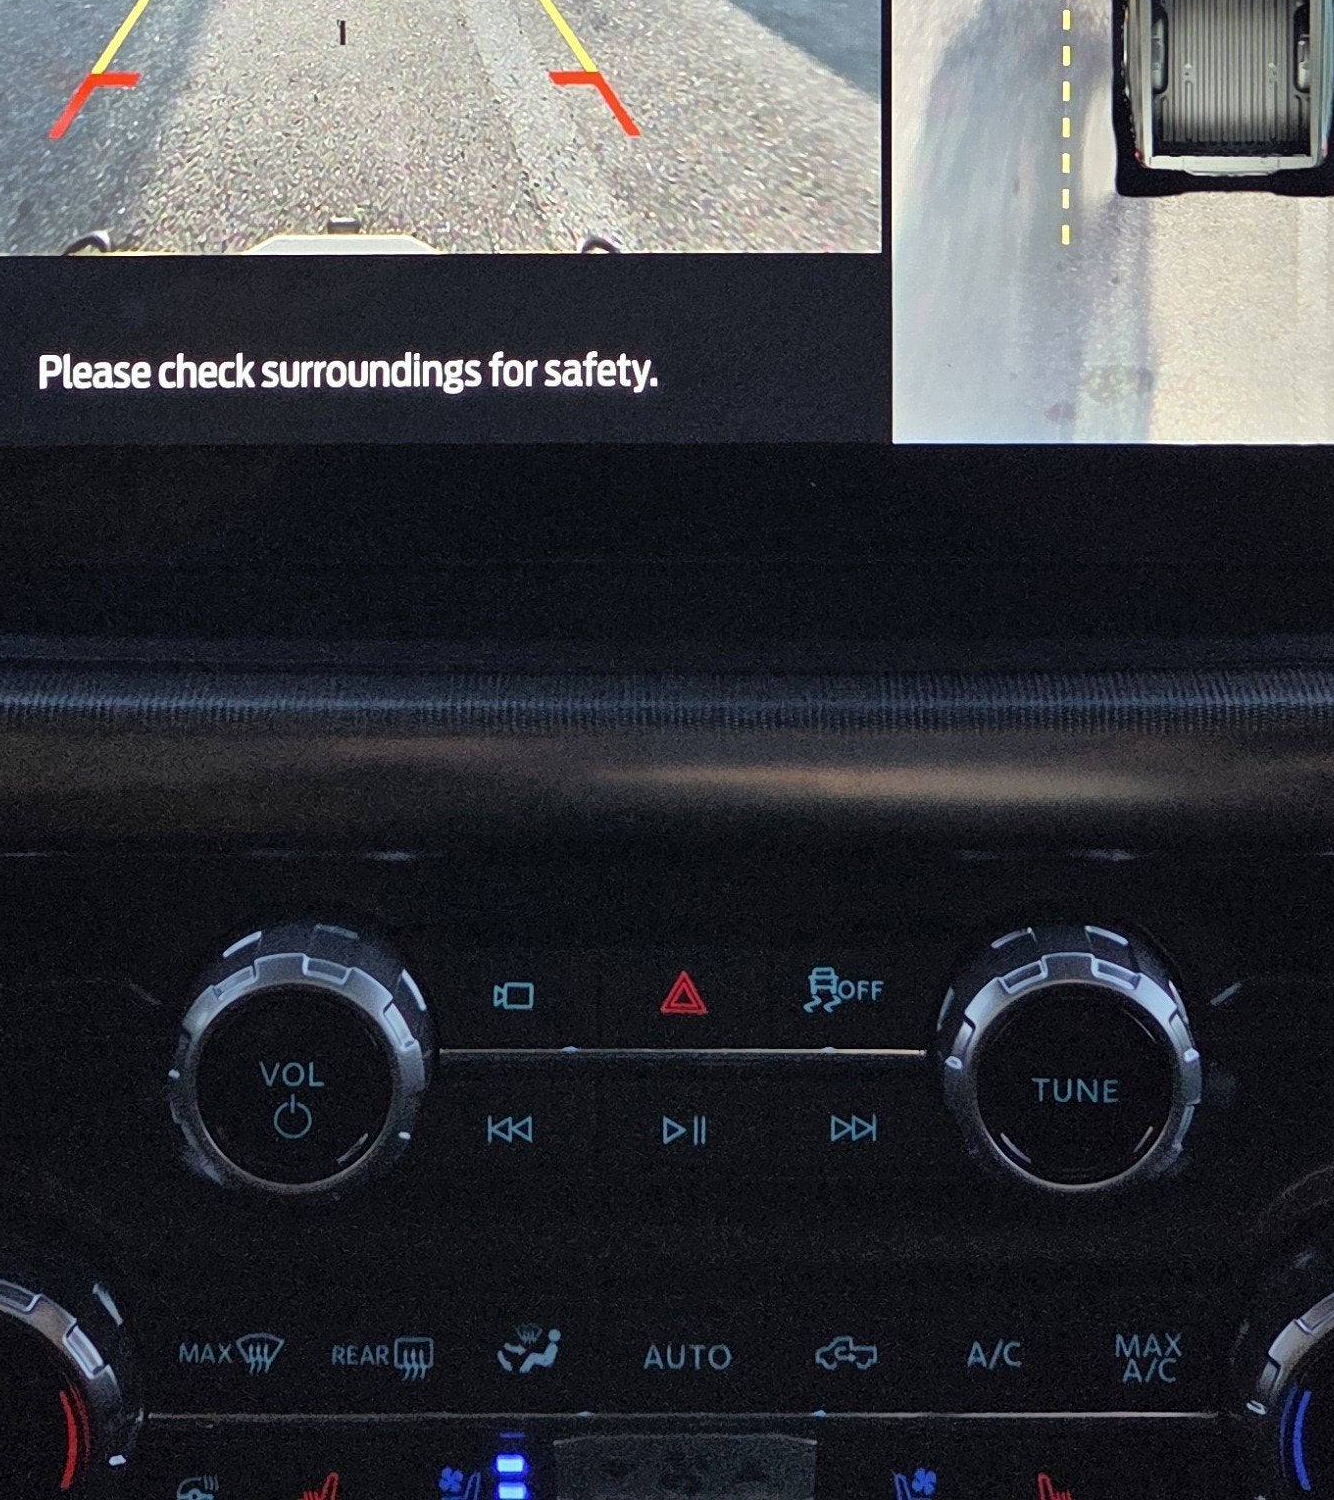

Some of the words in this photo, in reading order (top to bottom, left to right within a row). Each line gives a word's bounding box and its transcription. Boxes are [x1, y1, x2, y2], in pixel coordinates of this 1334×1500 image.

[39, 354, 151, 389] Please
[158, 353, 255, 388] check
[261, 352, 482, 394] surroundings
[489, 351, 538, 387] for
[544, 351, 658, 393] safety.
[838, 980, 884, 1000] OFF
[260, 1062, 324, 1087] VOL
[1032, 1078, 1117, 1103] TUNE
[179, 1343, 232, 1363] MAX
[332, 1345, 389, 1365] REAR
[644, 1344, 732, 1369] AUTO
[967, 1340, 1021, 1369] A/C
[1116, 1334, 1181, 1357] MAX
[1123, 1358, 1176, 1382] A/C
